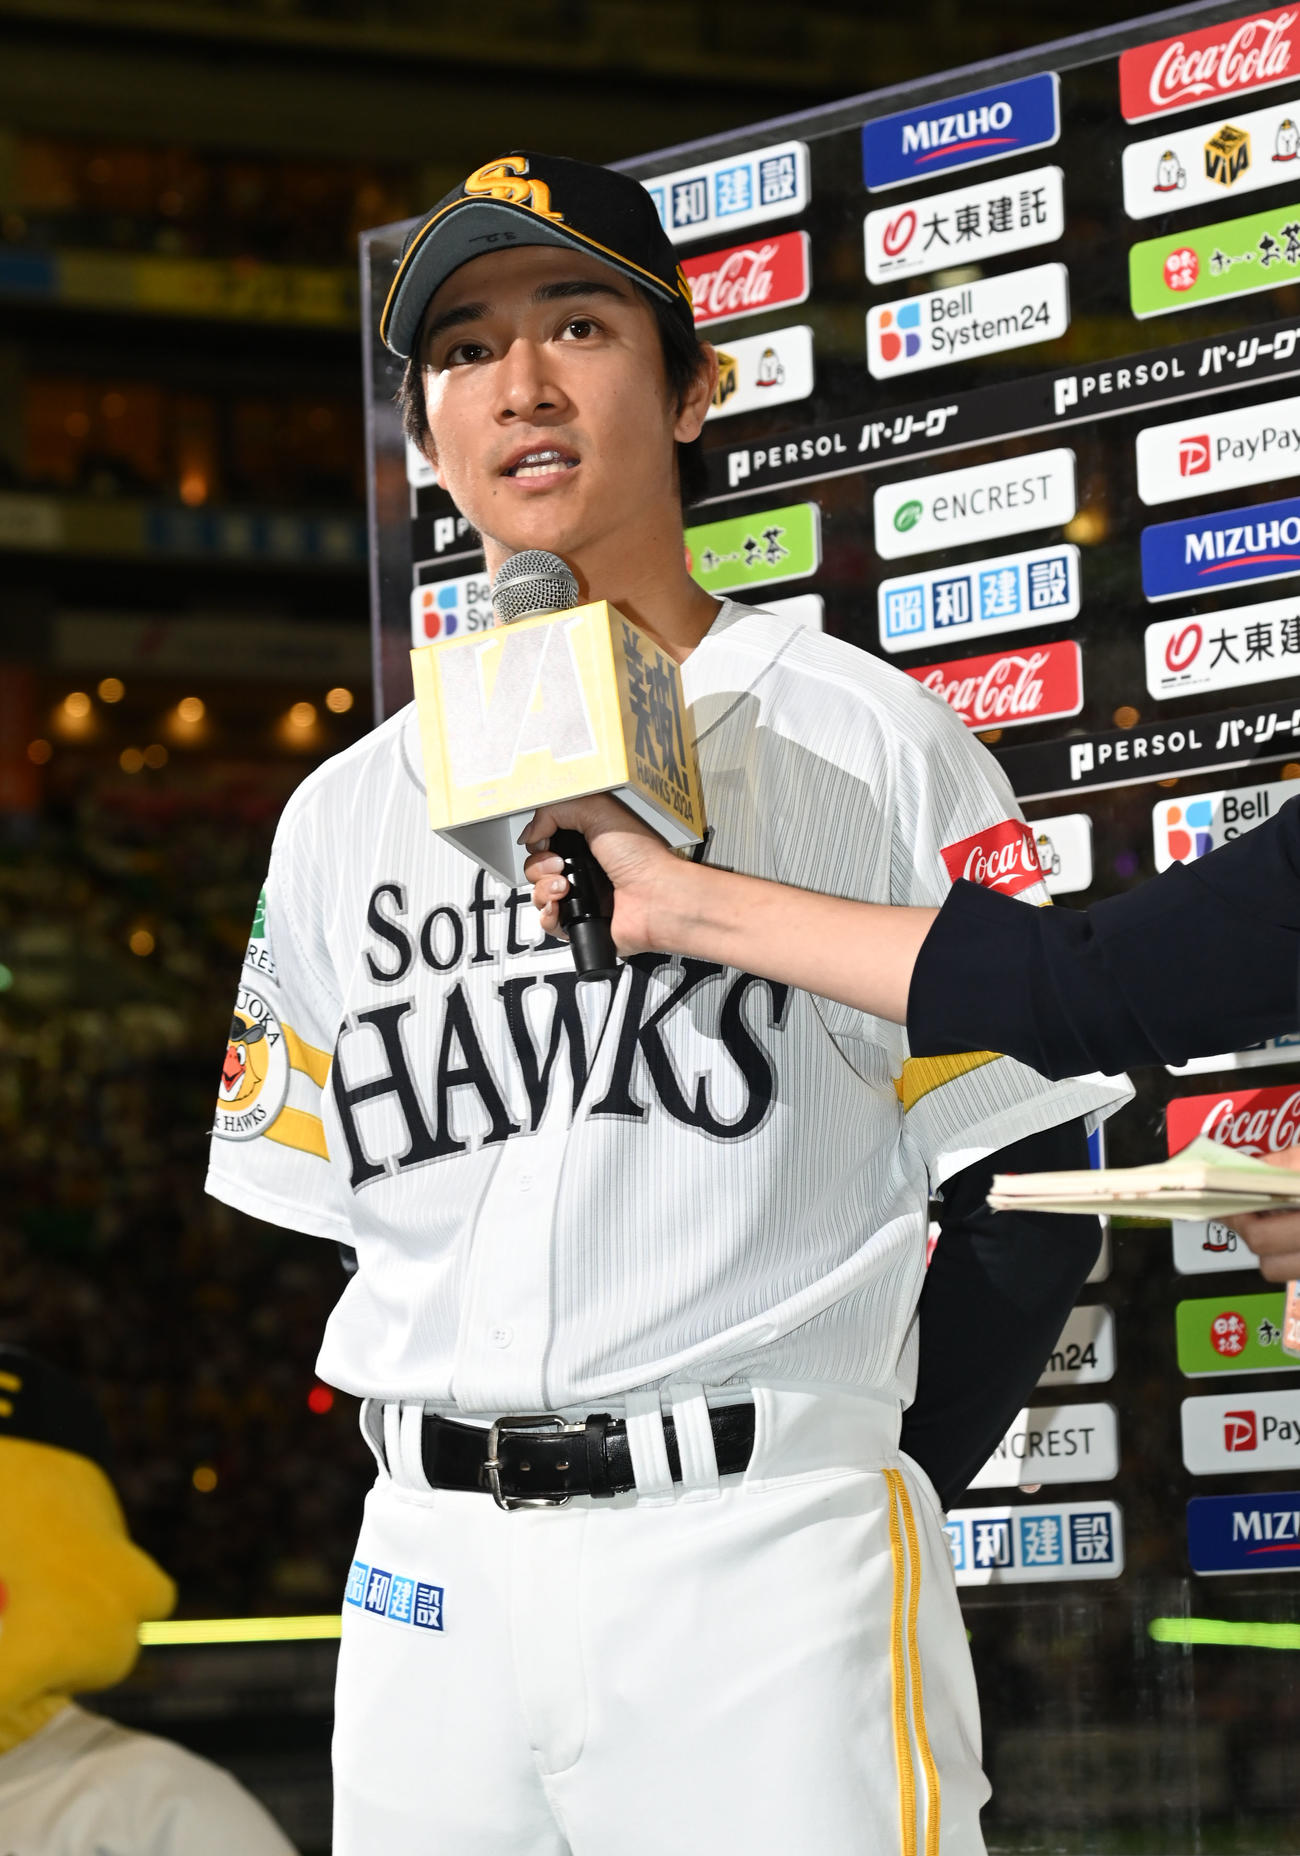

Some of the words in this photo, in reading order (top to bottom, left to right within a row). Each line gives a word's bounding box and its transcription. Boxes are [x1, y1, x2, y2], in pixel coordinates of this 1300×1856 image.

[1150, 12, 1298, 105] Coca-Cola
[901, 101, 1013, 155] MIZUHO
[922, 187, 1047, 251] 大東建託
[687, 244, 779, 318] ca-Cola
[931, 290, 972, 323] Bell
[931, 301, 1051, 355] System24
[1082, 357, 1185, 398] PERSOL
[753, 433, 847, 470] PERSOL
[1185, 517, 1300, 565] MIZUHO
[466, 582, 491, 605] Be
[885, 556, 1070, 638] 昭和建設
[1098, 729, 1202, 764] PERSOL
[671, 784, 694, 824] 2024
[1223, 790, 1270, 823] Bell
[963, 833, 1039, 888] Coca-C
[237, 990, 280, 1047] UOKA
[330, 951, 790, 1195] HAWKS
[223, 1103, 267, 1131] HAWKS
[1201, 1089, 1300, 1154] Coca-C
[994, 1427, 1096, 1460] NCREST
